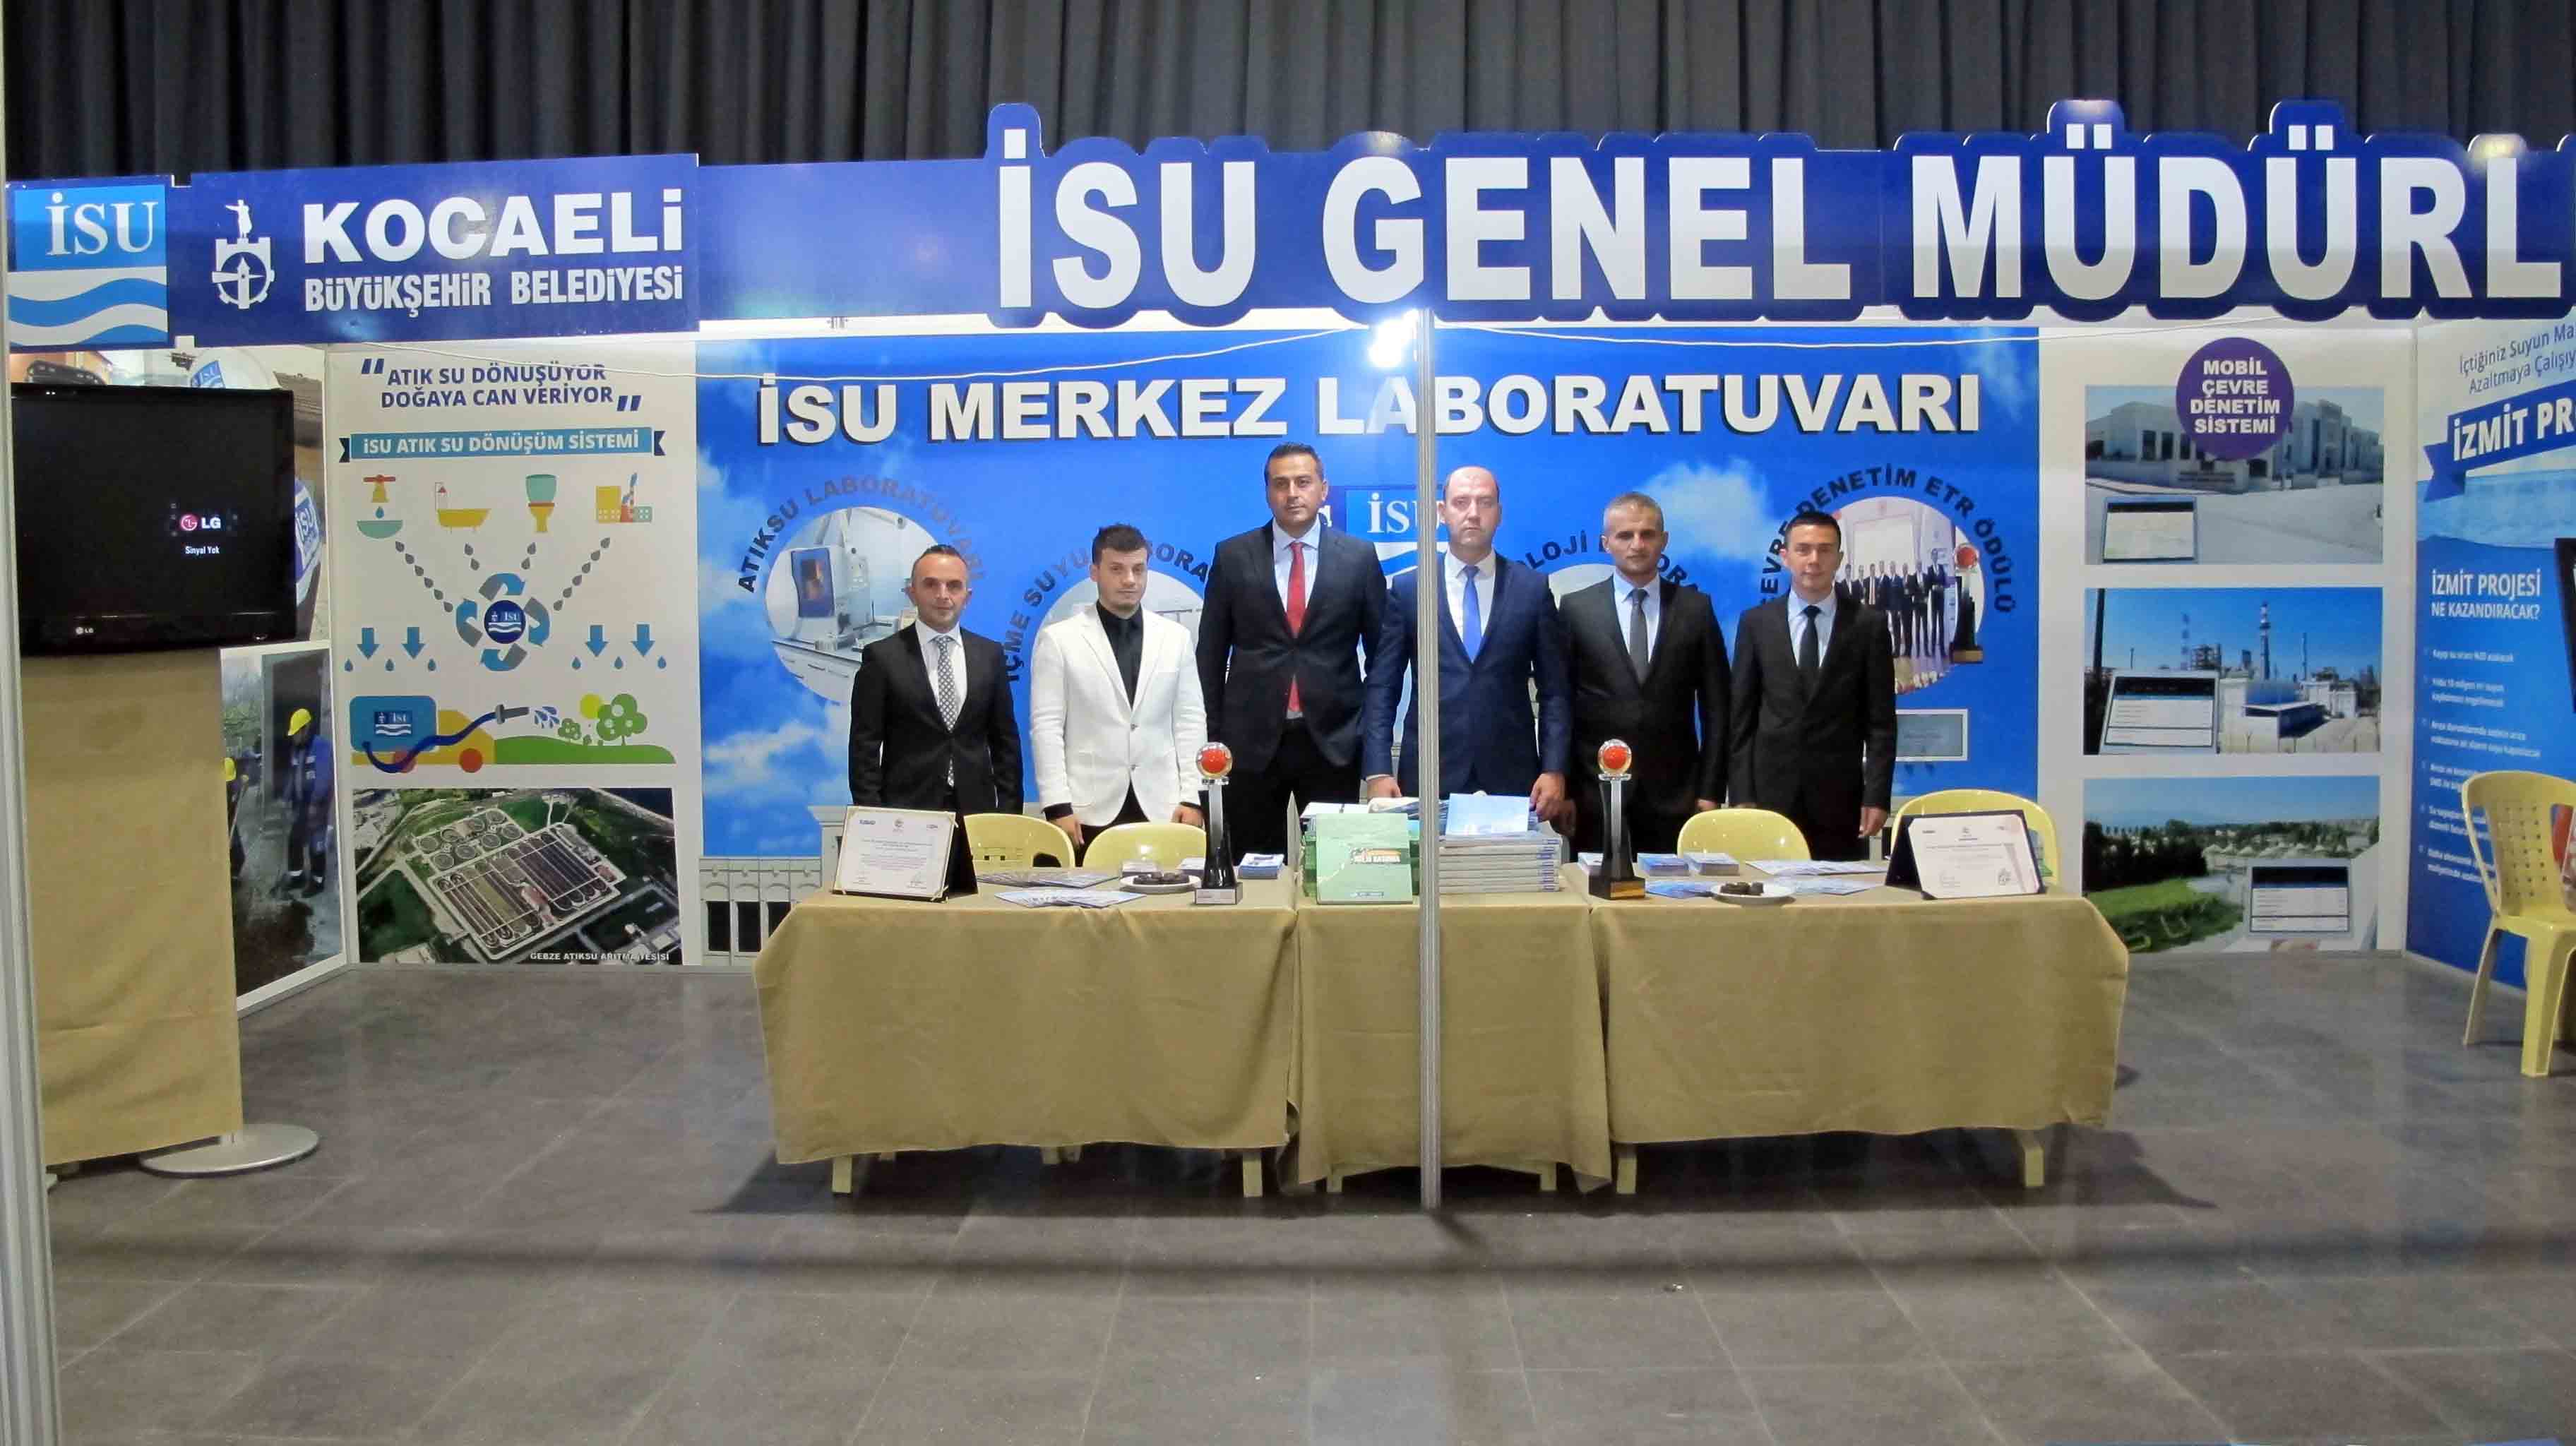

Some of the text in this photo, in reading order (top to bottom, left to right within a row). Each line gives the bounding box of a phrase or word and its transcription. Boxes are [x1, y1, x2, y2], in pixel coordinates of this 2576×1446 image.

[45, 191, 159, 259] İSU
[998, 123, 2563, 309] İSU GENEL MÜDÜRL
[2510, 330, 2549, 357] Suyun
[2553, 323, 2576, 343] Ma
[388, 361, 607, 387] ATIK SU DÖNÜŞÜYOR
[2203, 357, 2268, 376] MOBİL
[2469, 363, 2531, 394] Azaltmaya
[381, 383, 613, 409] DOĞAYA CAN VERİYOR
[2202, 379, 2269, 398] ÇEVRE
[928, 377, 1288, 442] MERKEZ
[1318, 373, 1980, 436] LABORATUVARI
[2190, 396, 2281, 414] DENETİM
[2194, 414, 2277, 434] SİSTEMİ
[2453, 398, 2576, 462] İZMİT PR
[397, 438, 436, 454] ATIK
[440, 437, 463, 453] SU
[469, 432, 564, 455] DÖNÜŞÜM
[568, 429, 639, 450] SİSTEMİ
[201, 517, 221, 530] LG
[185, 545, 220, 556] Sinyal Yok
[738, 498, 799, 594] ATIKSU
[1796, 462, 1918, 516] DENETİM
[1924, 476, 1975, 518] ETR
[1974, 518, 2016, 613] ÖDÜLÜ
[2431, 568, 2541, 602] İZMİT PROJESİ
[2431, 602, 2541, 621] NE KAZANDIRACAK?
